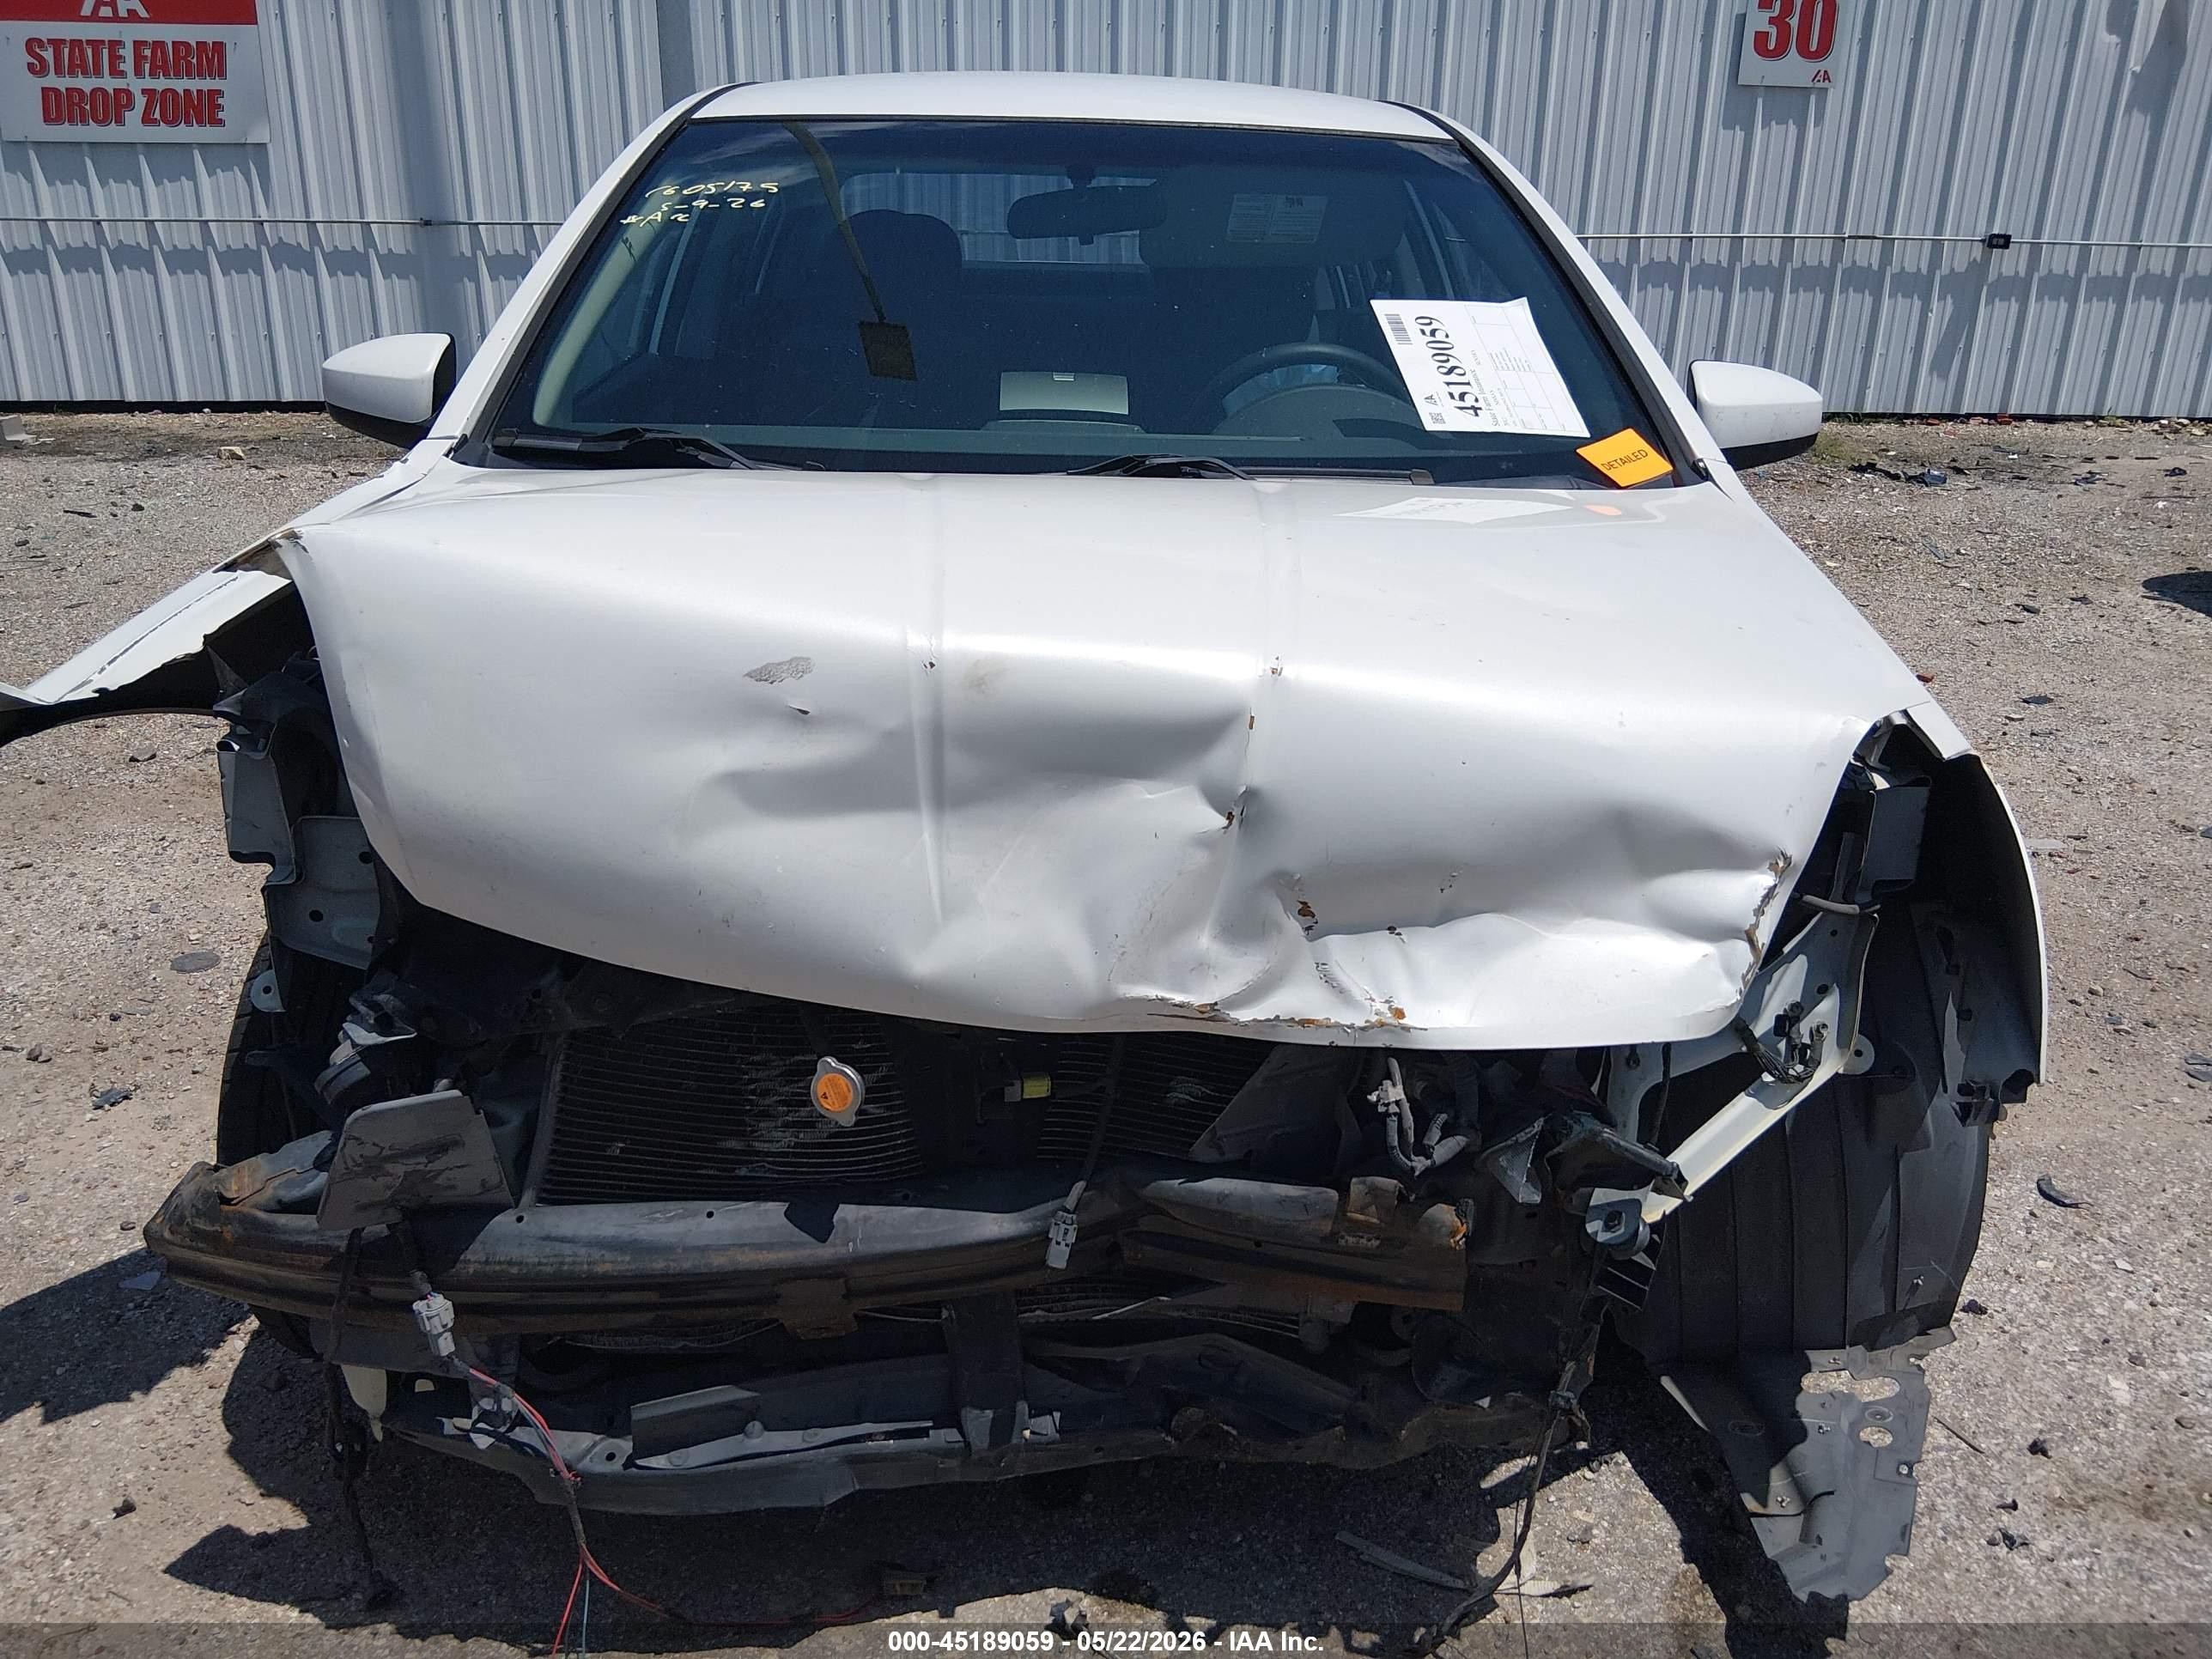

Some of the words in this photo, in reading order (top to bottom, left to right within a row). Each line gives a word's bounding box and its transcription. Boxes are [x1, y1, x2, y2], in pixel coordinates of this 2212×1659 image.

[1753, 0, 1838, 61] 30
[26, 39, 126, 78] STATE
[133, 40, 227, 80] FARM
[41, 87, 134, 125] DROP
[141, 88, 225, 127] ZONE
[1415, 316, 1483, 418] 45189059
[1489, 412, 1501, 427] State
[1600, 449, 1649, 471] DETAILED
